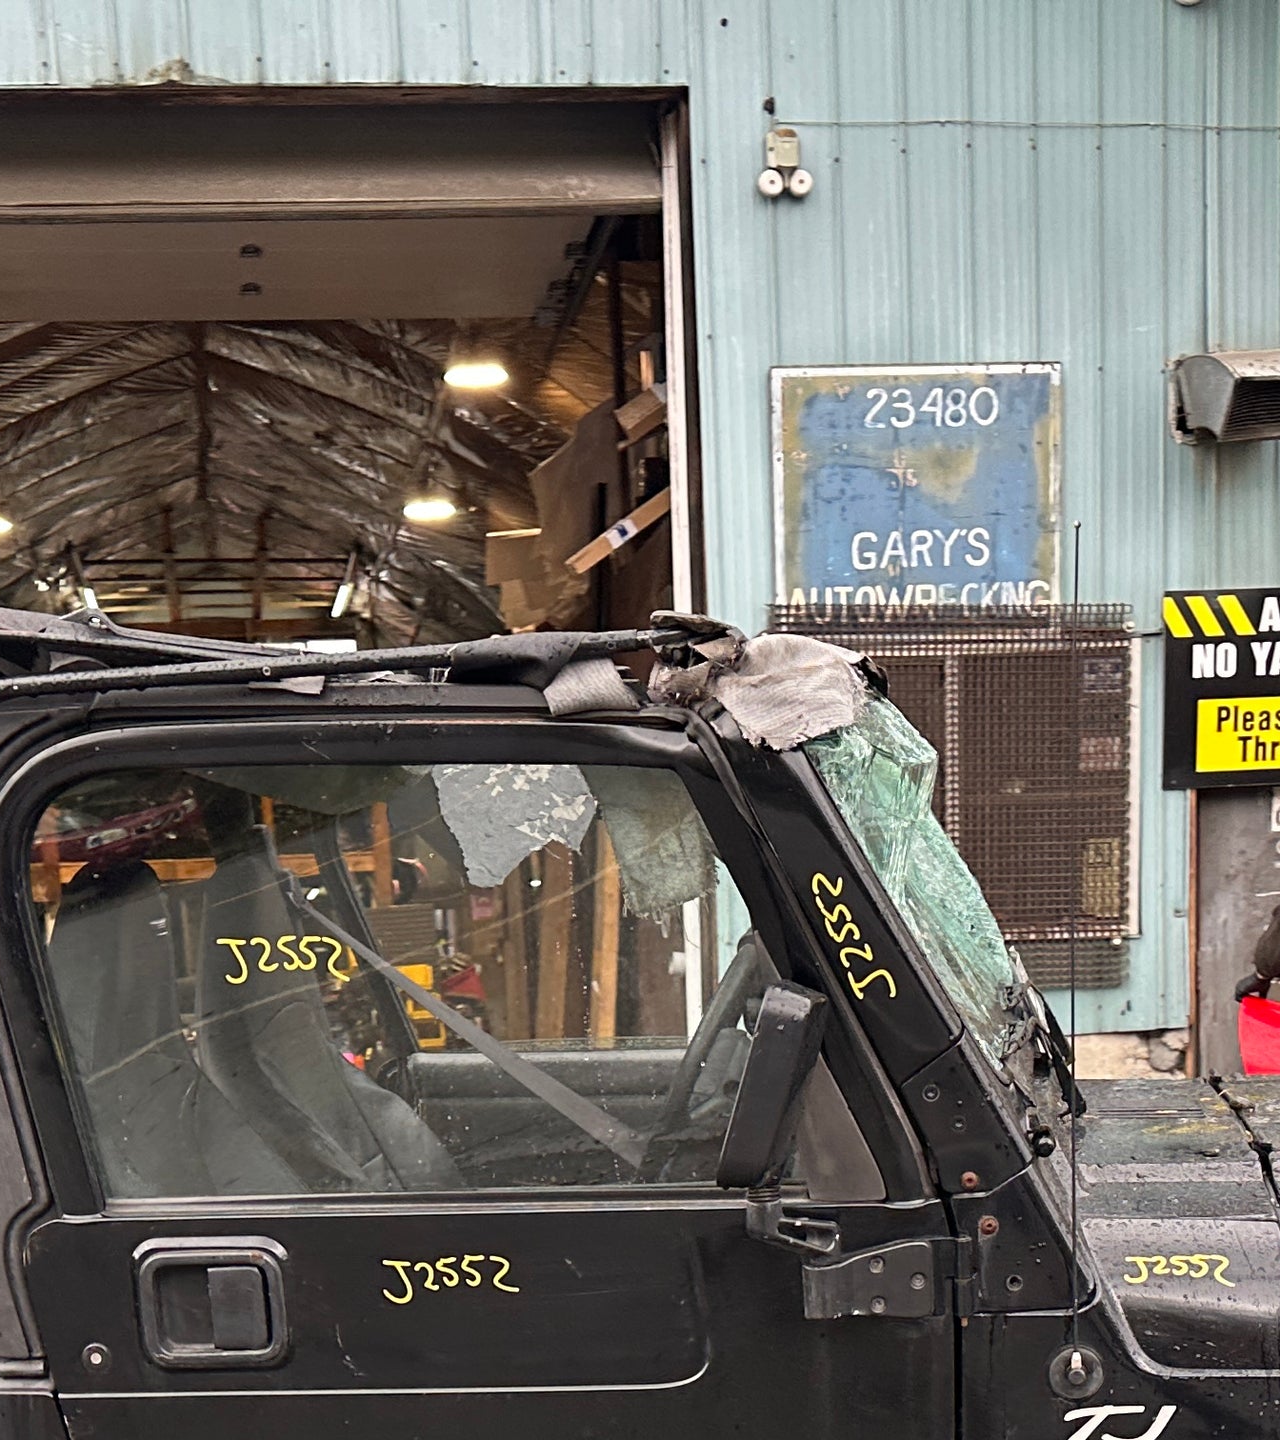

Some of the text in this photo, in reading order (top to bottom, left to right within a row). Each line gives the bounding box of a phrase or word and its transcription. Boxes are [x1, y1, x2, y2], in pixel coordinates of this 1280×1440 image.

[863, 386, 1000, 429] 23480
[850, 526, 991, 571] GARY'S
[1191, 642, 1239, 679] NO
[811, 872, 897, 1000] J2552
[216, 934, 351, 985] J2552
[382, 1254, 520, 1305] J2552
[1123, 1253, 1236, 1288] J2552
